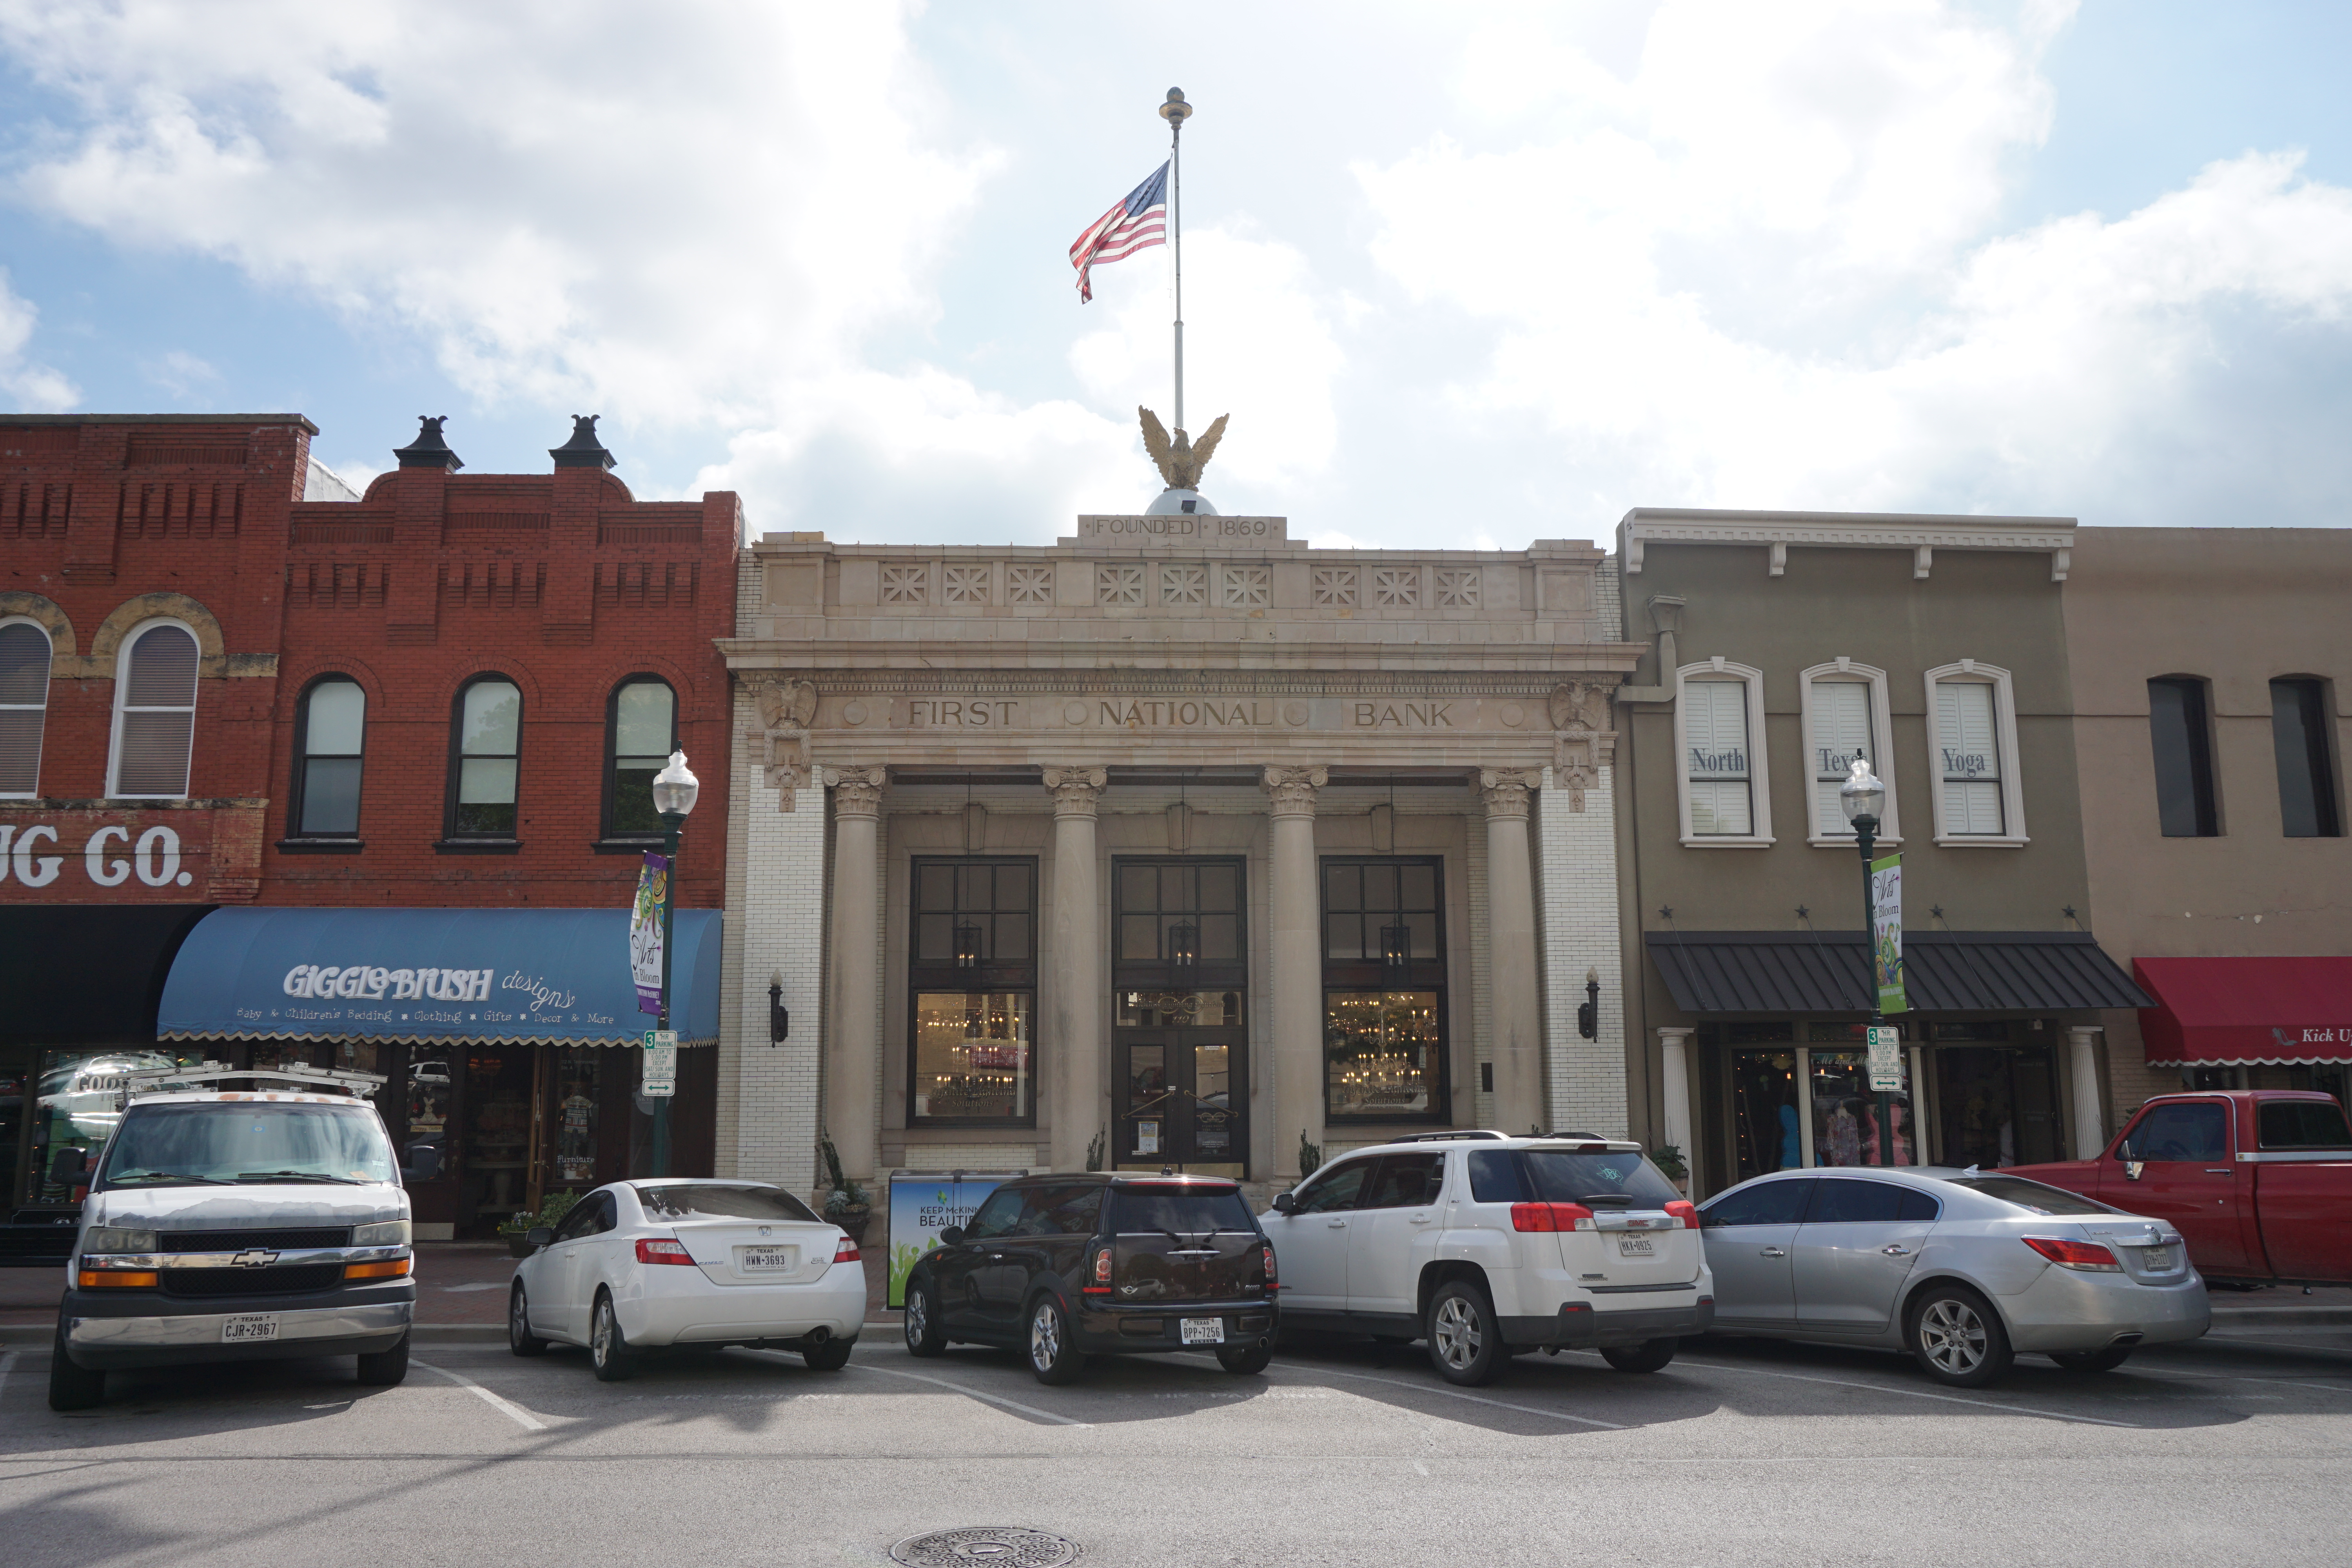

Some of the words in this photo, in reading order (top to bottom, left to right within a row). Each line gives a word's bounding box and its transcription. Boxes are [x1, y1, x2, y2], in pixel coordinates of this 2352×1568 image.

[1096, 519, 1193, 534] FOUNDED
[1218, 520, 1266, 535] 1869
[908, 701, 1018, 725] FIRST
[1100, 701, 1272, 725] NATIONAL
[1355, 704, 1453, 726] BANK
[1692, 748, 1745, 771] North
[1819, 749, 1867, 771] Tex
[1941, 749, 1985, 777] Yoga
[85, 825, 192, 887] CO.
[1873, 871, 1896, 910] Arts
[1878, 905, 1899, 920] Bloom
[632, 935, 657, 971] Arts
[640, 968, 660, 984] Bloom
[502, 970, 575, 1011] designs
[237, 1008, 262, 1020] Baby
[285, 1008, 341, 1019] Children's
[348, 1009, 392, 1023] Bedding
[414, 1011, 462, 1024] Clothing
[484, 1011, 512, 1021] Gifts
[534, 1013, 563, 1023] Decor
[571, 1013, 579, 1022] &
[587, 1013, 614, 1024] More
[647, 1034, 653, 1047] 3
[1869, 1031, 1877, 1043] 3
[2301, 1028, 2334, 1042] Kick
[1835, 1056, 1849, 1064] and
[972, 1086, 1016, 1099] Lighting
[1383, 1084, 1427, 1096] Lighting
[557, 1155, 595, 1163] Furniture
